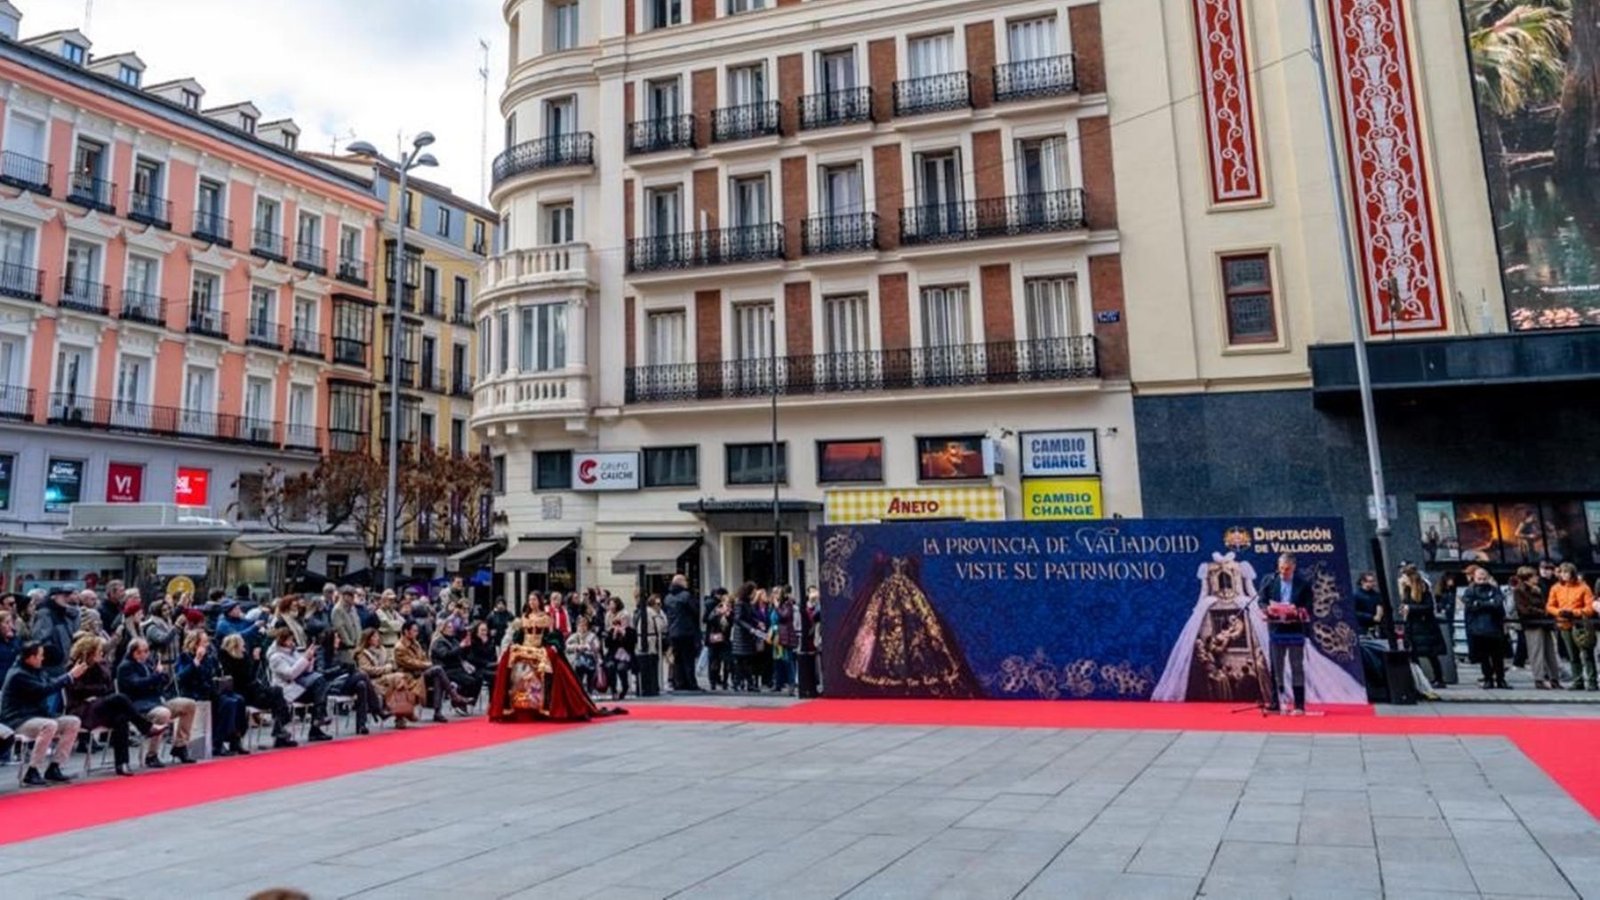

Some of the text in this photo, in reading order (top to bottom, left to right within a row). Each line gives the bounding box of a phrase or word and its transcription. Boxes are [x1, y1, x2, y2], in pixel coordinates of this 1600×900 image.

[1031, 438, 1086, 453] CAMBIO
[1032, 454, 1087, 469] CHANGE
[600, 471, 633, 480] CALICHE
[888, 497, 939, 514] ANETO
[1032, 493, 1092, 503] CAMBIO
[1032, 505, 1094, 516] CHANGE
[923, 527, 1200, 555] LA PROVINCIA DE VALLADOLID
[1271, 542, 1334, 553] VALLADOLID
[956, 561, 1165, 580] VISTE SU PATRIMONIO
